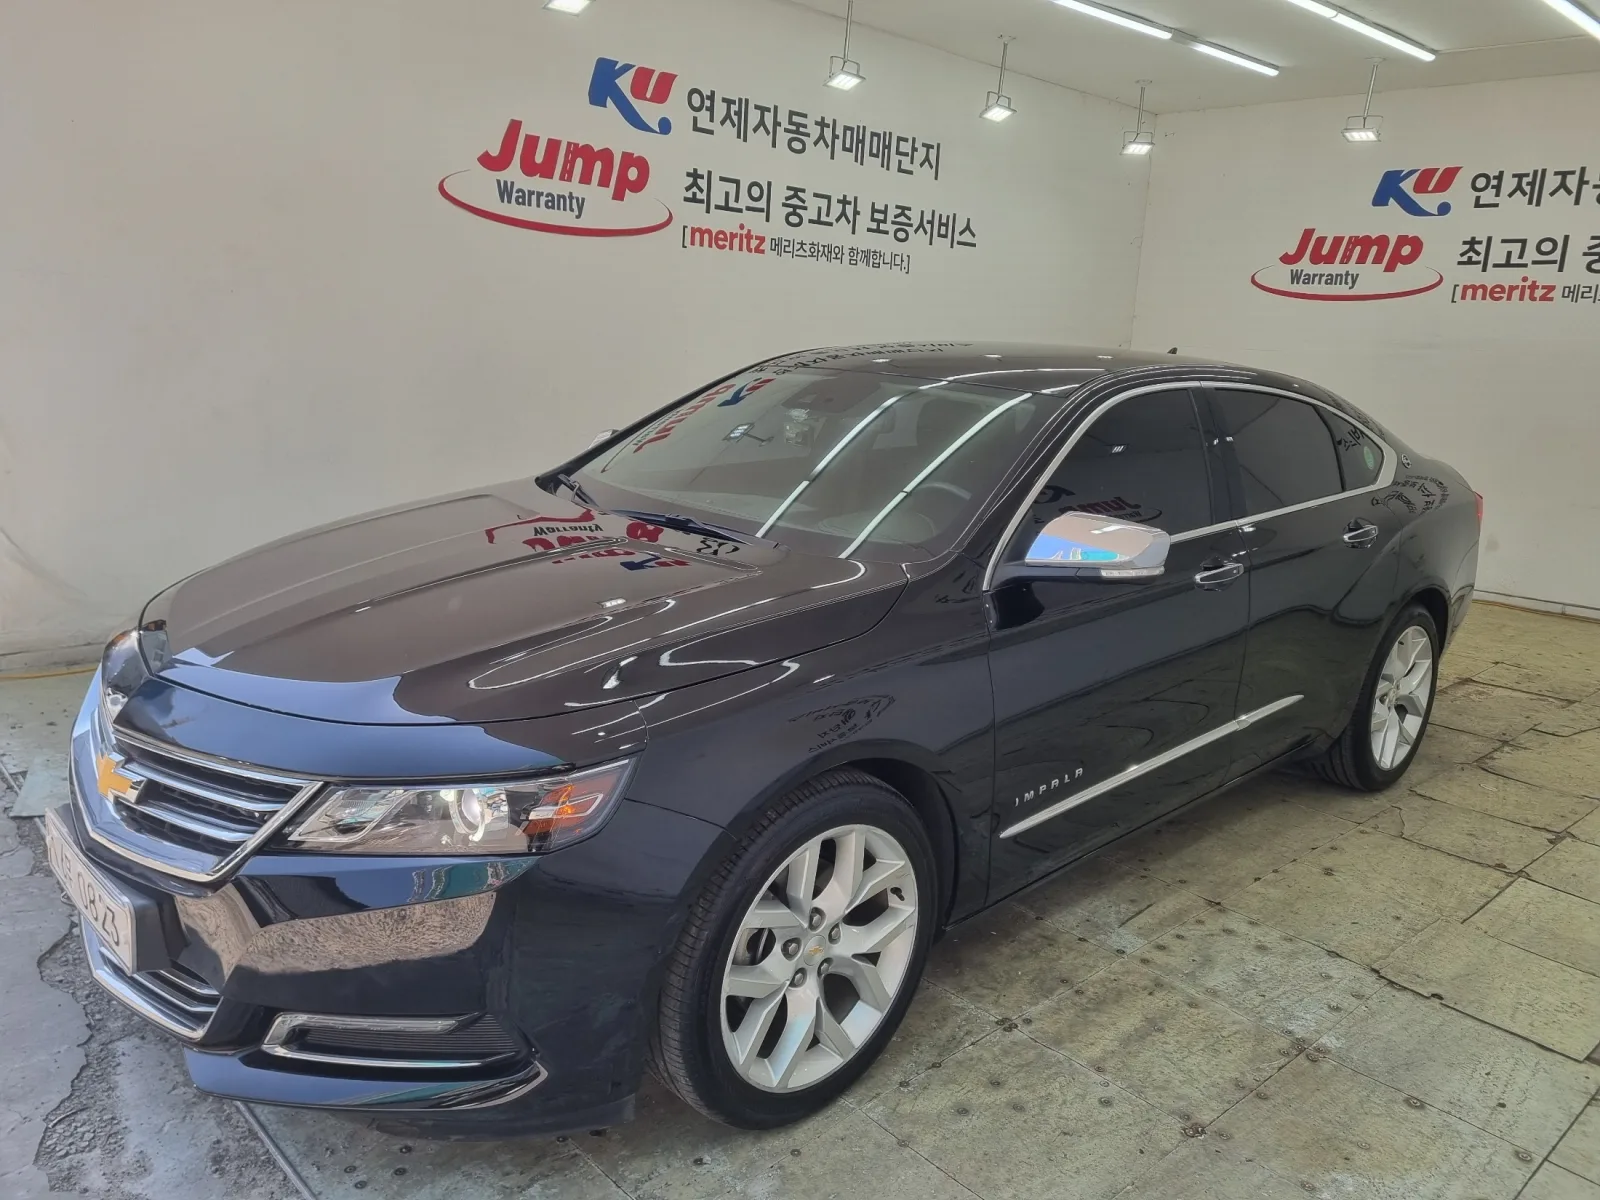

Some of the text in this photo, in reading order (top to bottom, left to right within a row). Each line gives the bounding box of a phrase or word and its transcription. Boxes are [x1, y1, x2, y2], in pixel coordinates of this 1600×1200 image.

[687, 87, 941, 181] 연제자동차매매단지
[477, 118, 650, 202] Jump
[496, 178, 586, 219] Warranty
[1470, 166, 1600, 208] 연제자
[683, 167, 977, 249] 최고의 중고차 보증서비스
[770, 236, 845, 265] 메리츠화재와
[848, 246, 911, 274] 함께합니다.]
[1278, 228, 1424, 272] Jump
[1457, 234, 1570, 272] 최고의
[1289, 269, 1359, 290] Warranty
[1561, 284, 1600, 304] 메리
[1014, 767, 1083, 807] IMPALA
